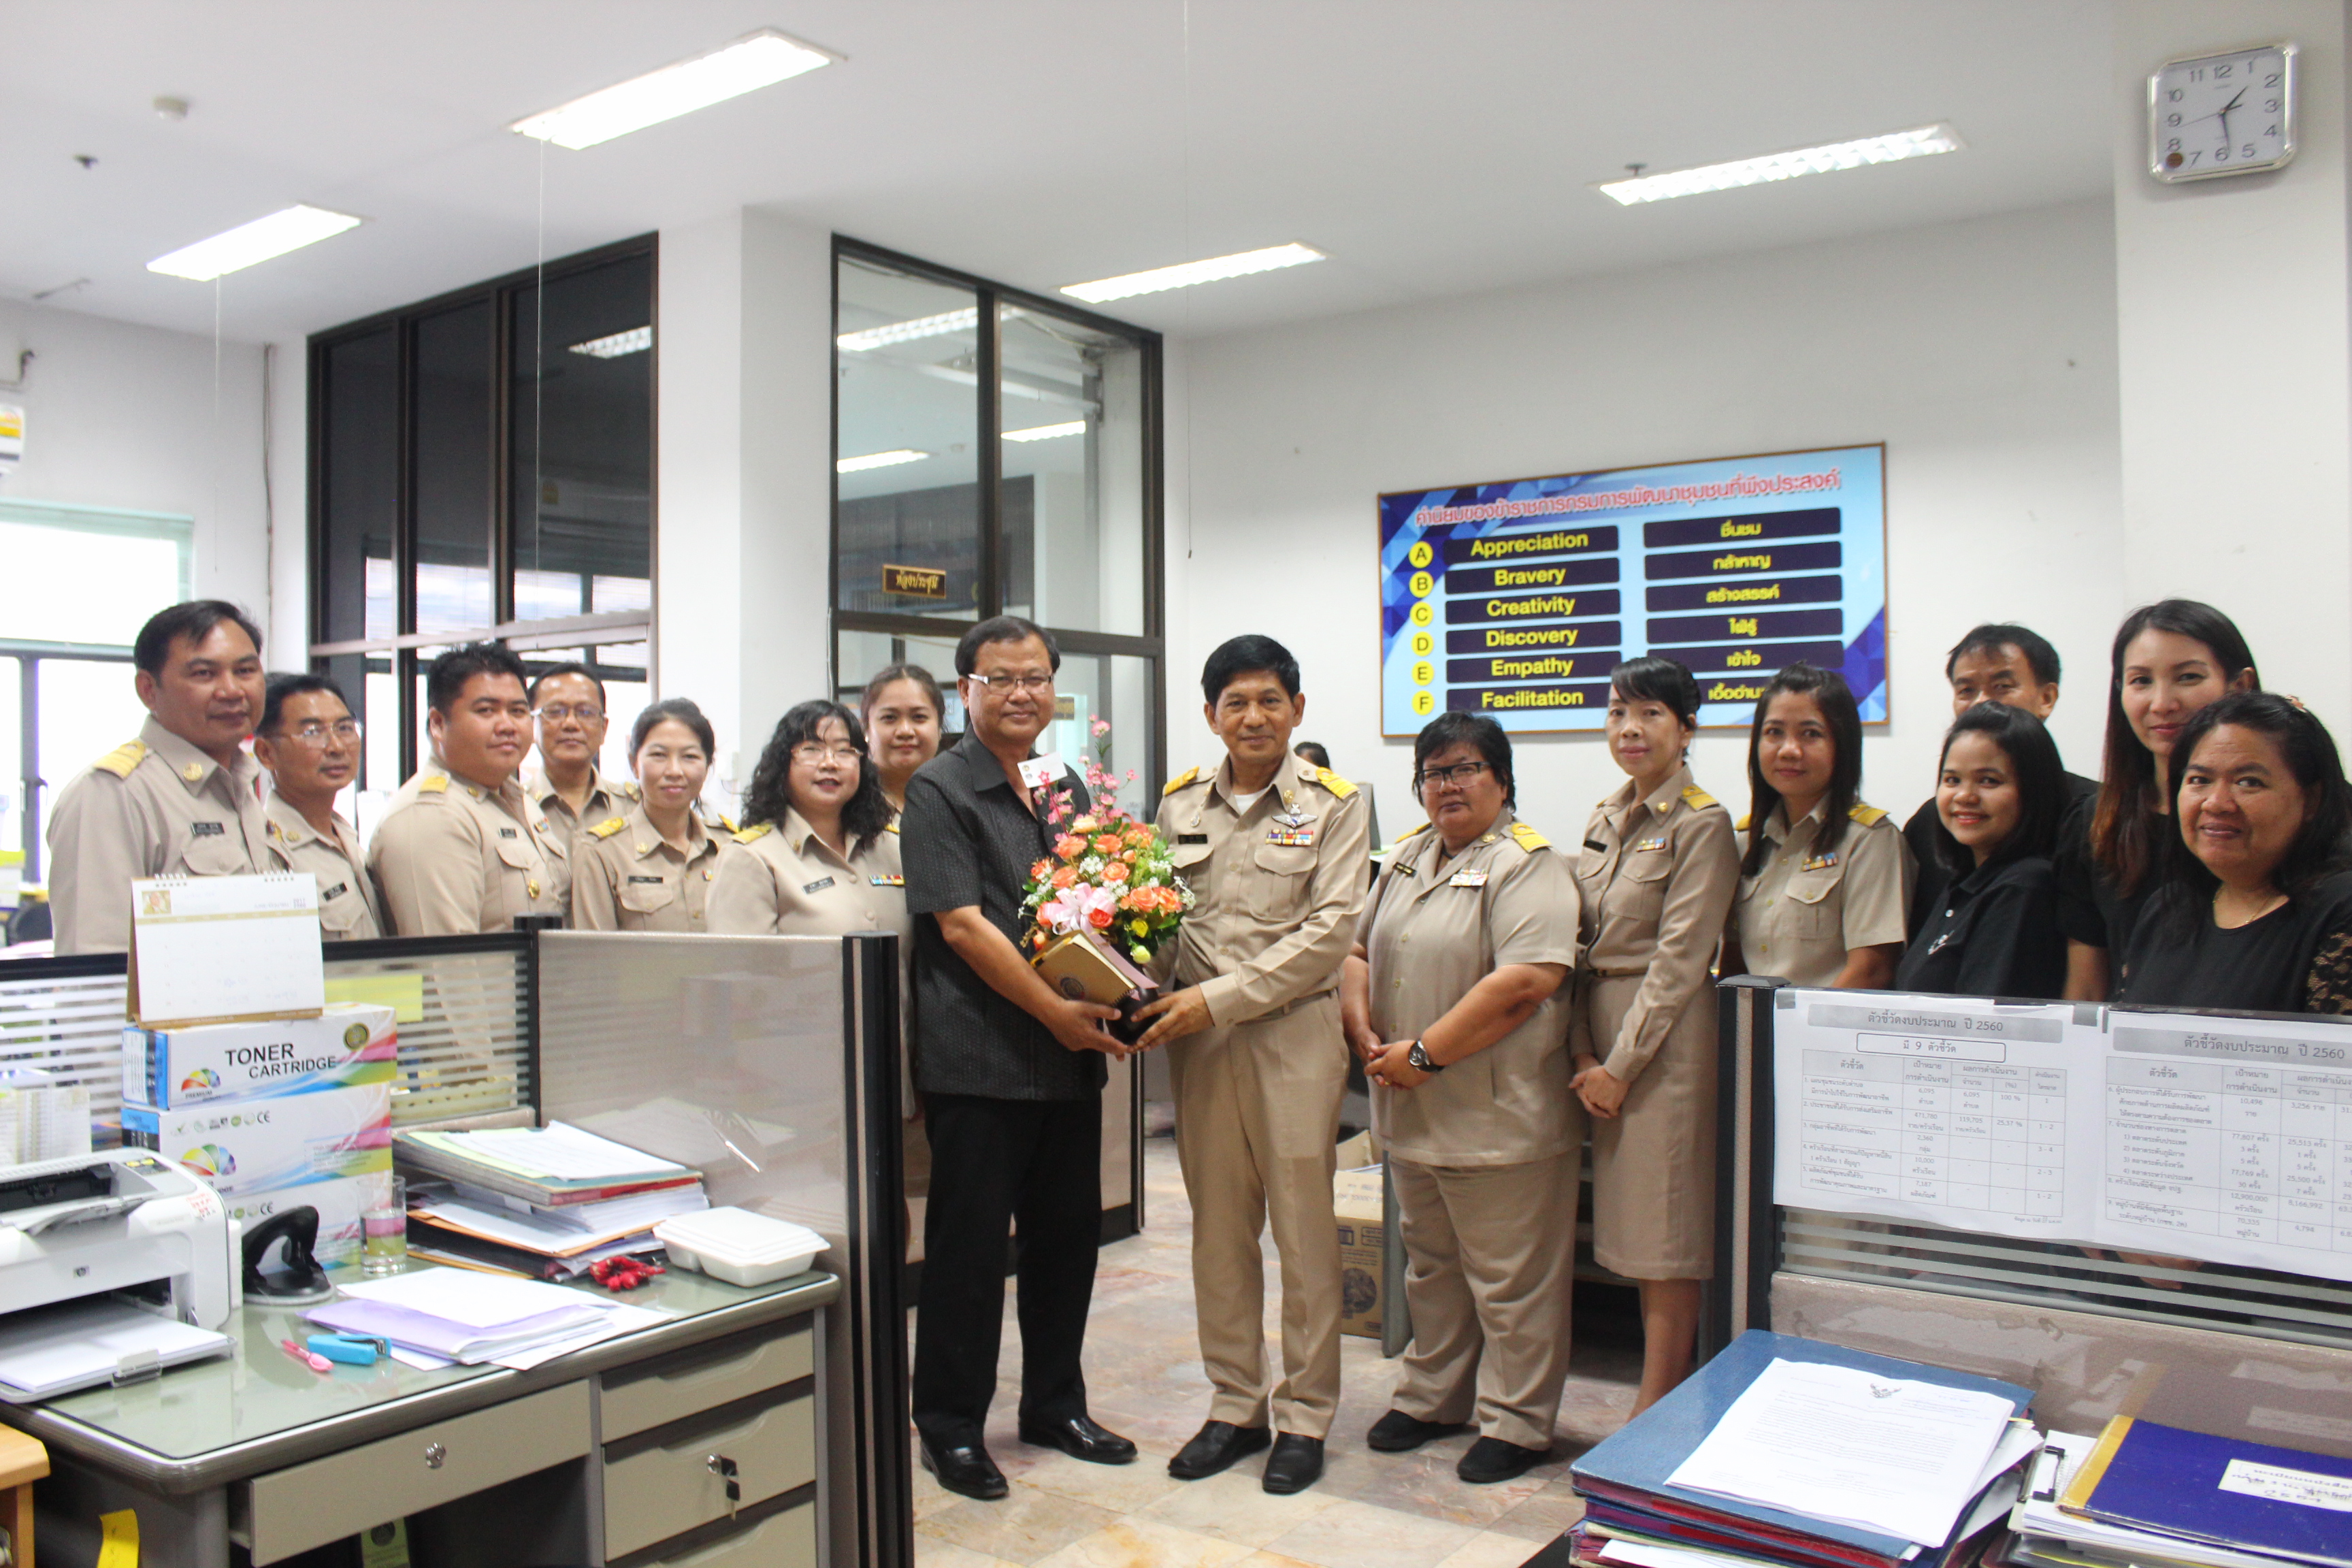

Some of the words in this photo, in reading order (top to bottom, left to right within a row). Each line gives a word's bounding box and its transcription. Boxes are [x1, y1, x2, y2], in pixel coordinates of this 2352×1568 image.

[2214, 65, 2232, 79] 12
[2247, 61, 2254, 74] 1
[2189, 69, 2203, 82] 11
[2264, 74, 2278, 88] 2
[2168, 89, 2183, 102] 10
[2264, 99, 2278, 113] 3
[2168, 113, 2181, 127] 9
[2264, 125, 2277, 137] 4
[2168, 138, 2180, 152] 8
[2242, 143, 2255, 158] 5
[2189, 151, 2202, 168] 7
[2215, 148, 2229, 161] 6
[1471, 533, 1588, 559] Appreciation
[1416, 548, 1427, 561] A
[1494, 568, 1566, 586] Bravery
[1418, 578, 1428, 590] B
[1487, 596, 1575, 617] Creativity
[1416, 608, 1427, 621] C
[1486, 628, 1578, 647] Discovery
[1418, 638, 1428, 651] D
[1418, 668, 1427, 680] E
[1491, 657, 1573, 678] Empathy
[1420, 697, 1429, 710] F
[1482, 689, 1584, 708] Facilitation
[1868, 1009, 1956, 1028] ตัวชี้วัดงบประมาณ
[1964, 1017, 1972, 1030] ปี
[1976, 1020, 2003, 1031] 2560
[1903, 1040, 1910, 1049] มี
[1916, 1041, 1922, 1050] 9
[1928, 1039, 1957, 1053] ตัวชี้วัด
[2185, 1033, 2288, 1056] ตัวชี้วัดงบประมาณ
[2298, 1044, 2307, 1057] ปี
[2313, 1047, 2345, 1060] 2560
[225, 1043, 294, 1068] TONER
[249, 1056, 336, 1079] CARTRIDGE
[1840, 1059, 1864, 1070] ตัวชี้วัด
[1913, 1060, 1942, 1069] เป้าหมาย
[1963, 1065, 2017, 1076] ผลการดำเนินงาน
[1905, 1074, 1948, 1083] การดำเนินงาน
[2149, 1066, 2178, 1079] ตัวชี้วัด
[2235, 1068, 2268, 1079] เป้าหมาย
[1962, 1078, 1982, 1086] จำนวน
[2297, 1075, 2352, 1085] ผลการดำเนินง
[185, 1090, 212, 1098] PREMIUM
[2226, 1083, 2277, 1094] การดำเนินงาน
[2297, 1088, 2320, 1096] จำนวน
